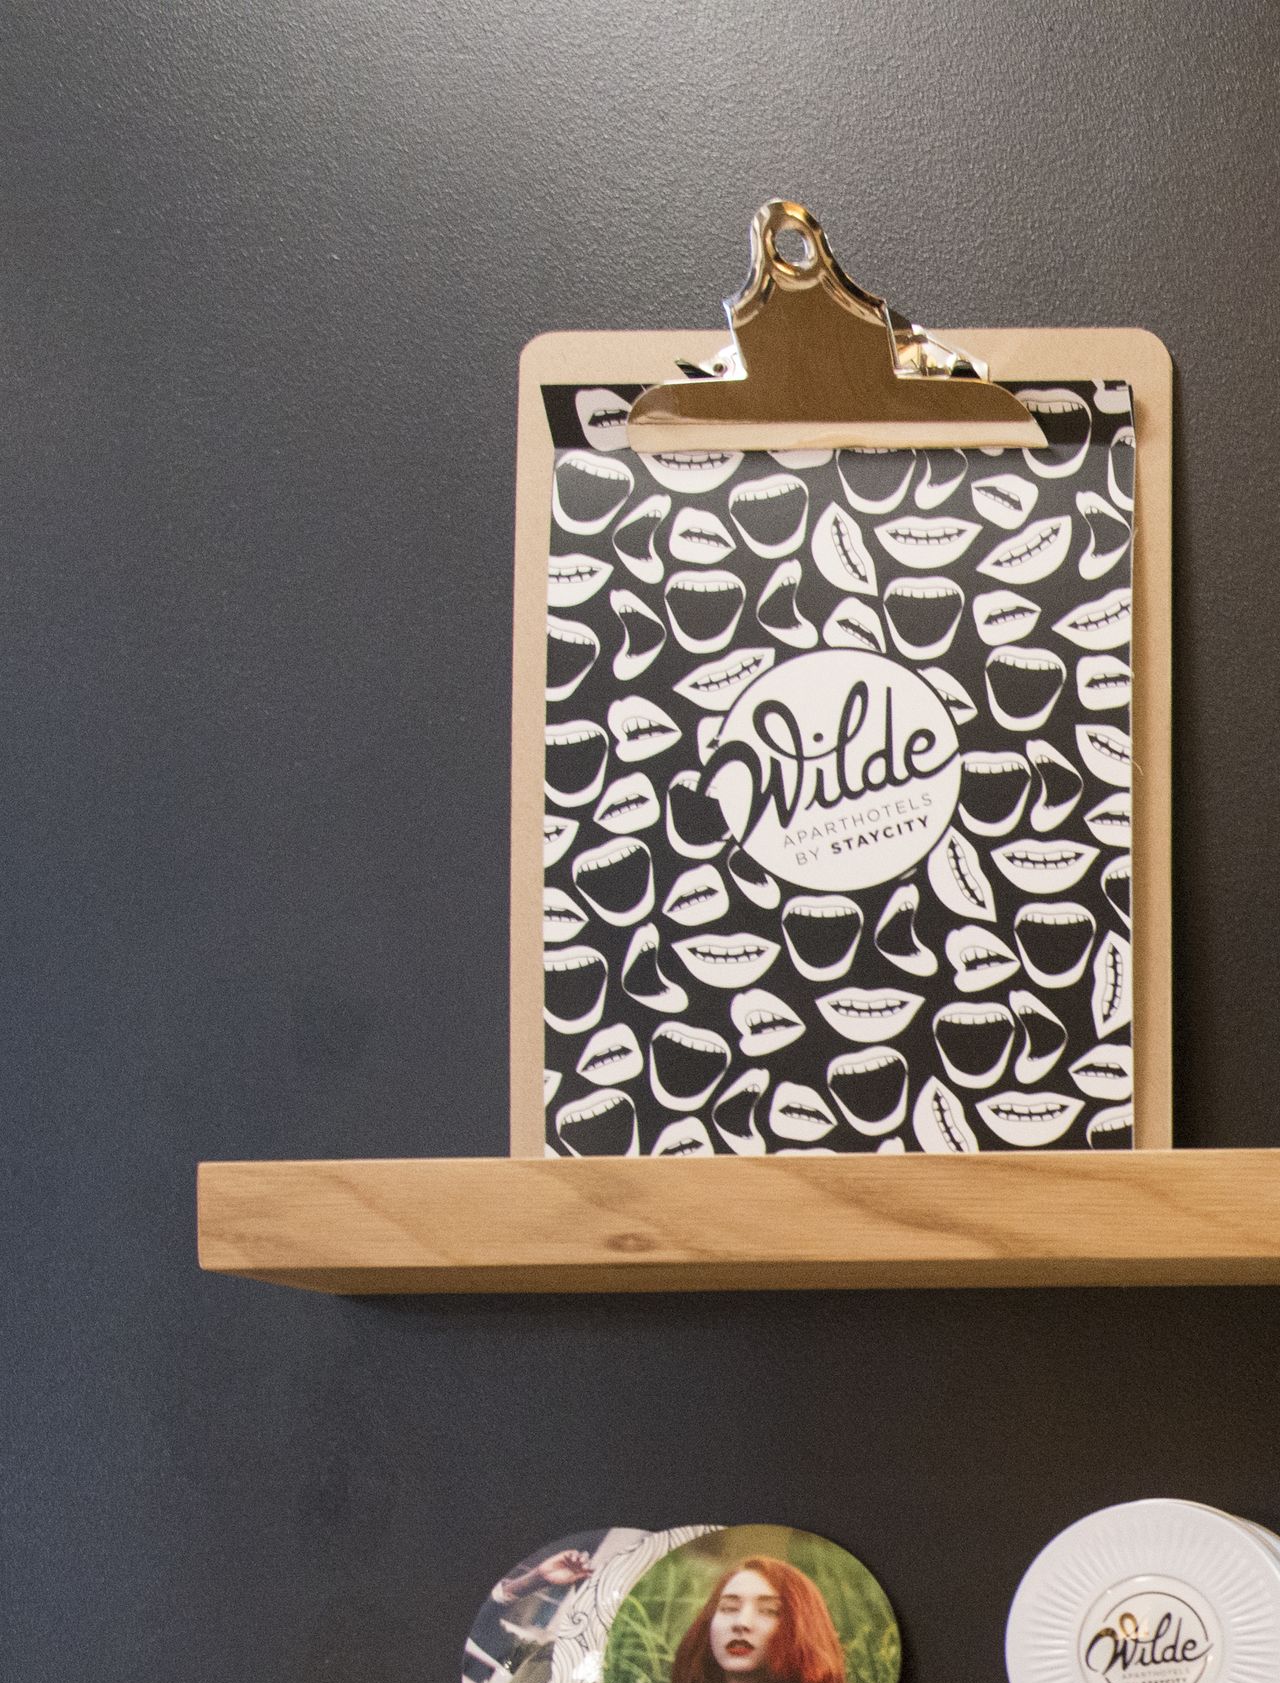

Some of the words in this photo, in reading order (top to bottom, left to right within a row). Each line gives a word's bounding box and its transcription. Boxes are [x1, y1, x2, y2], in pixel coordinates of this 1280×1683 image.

[697, 681, 959, 845] Wilde
[783, 792, 934, 848] APARTHOTELS
[795, 847, 822, 866] BY
[831, 815, 930, 855] STAYCITY
[1085, 1612, 1213, 1675] Wilde
